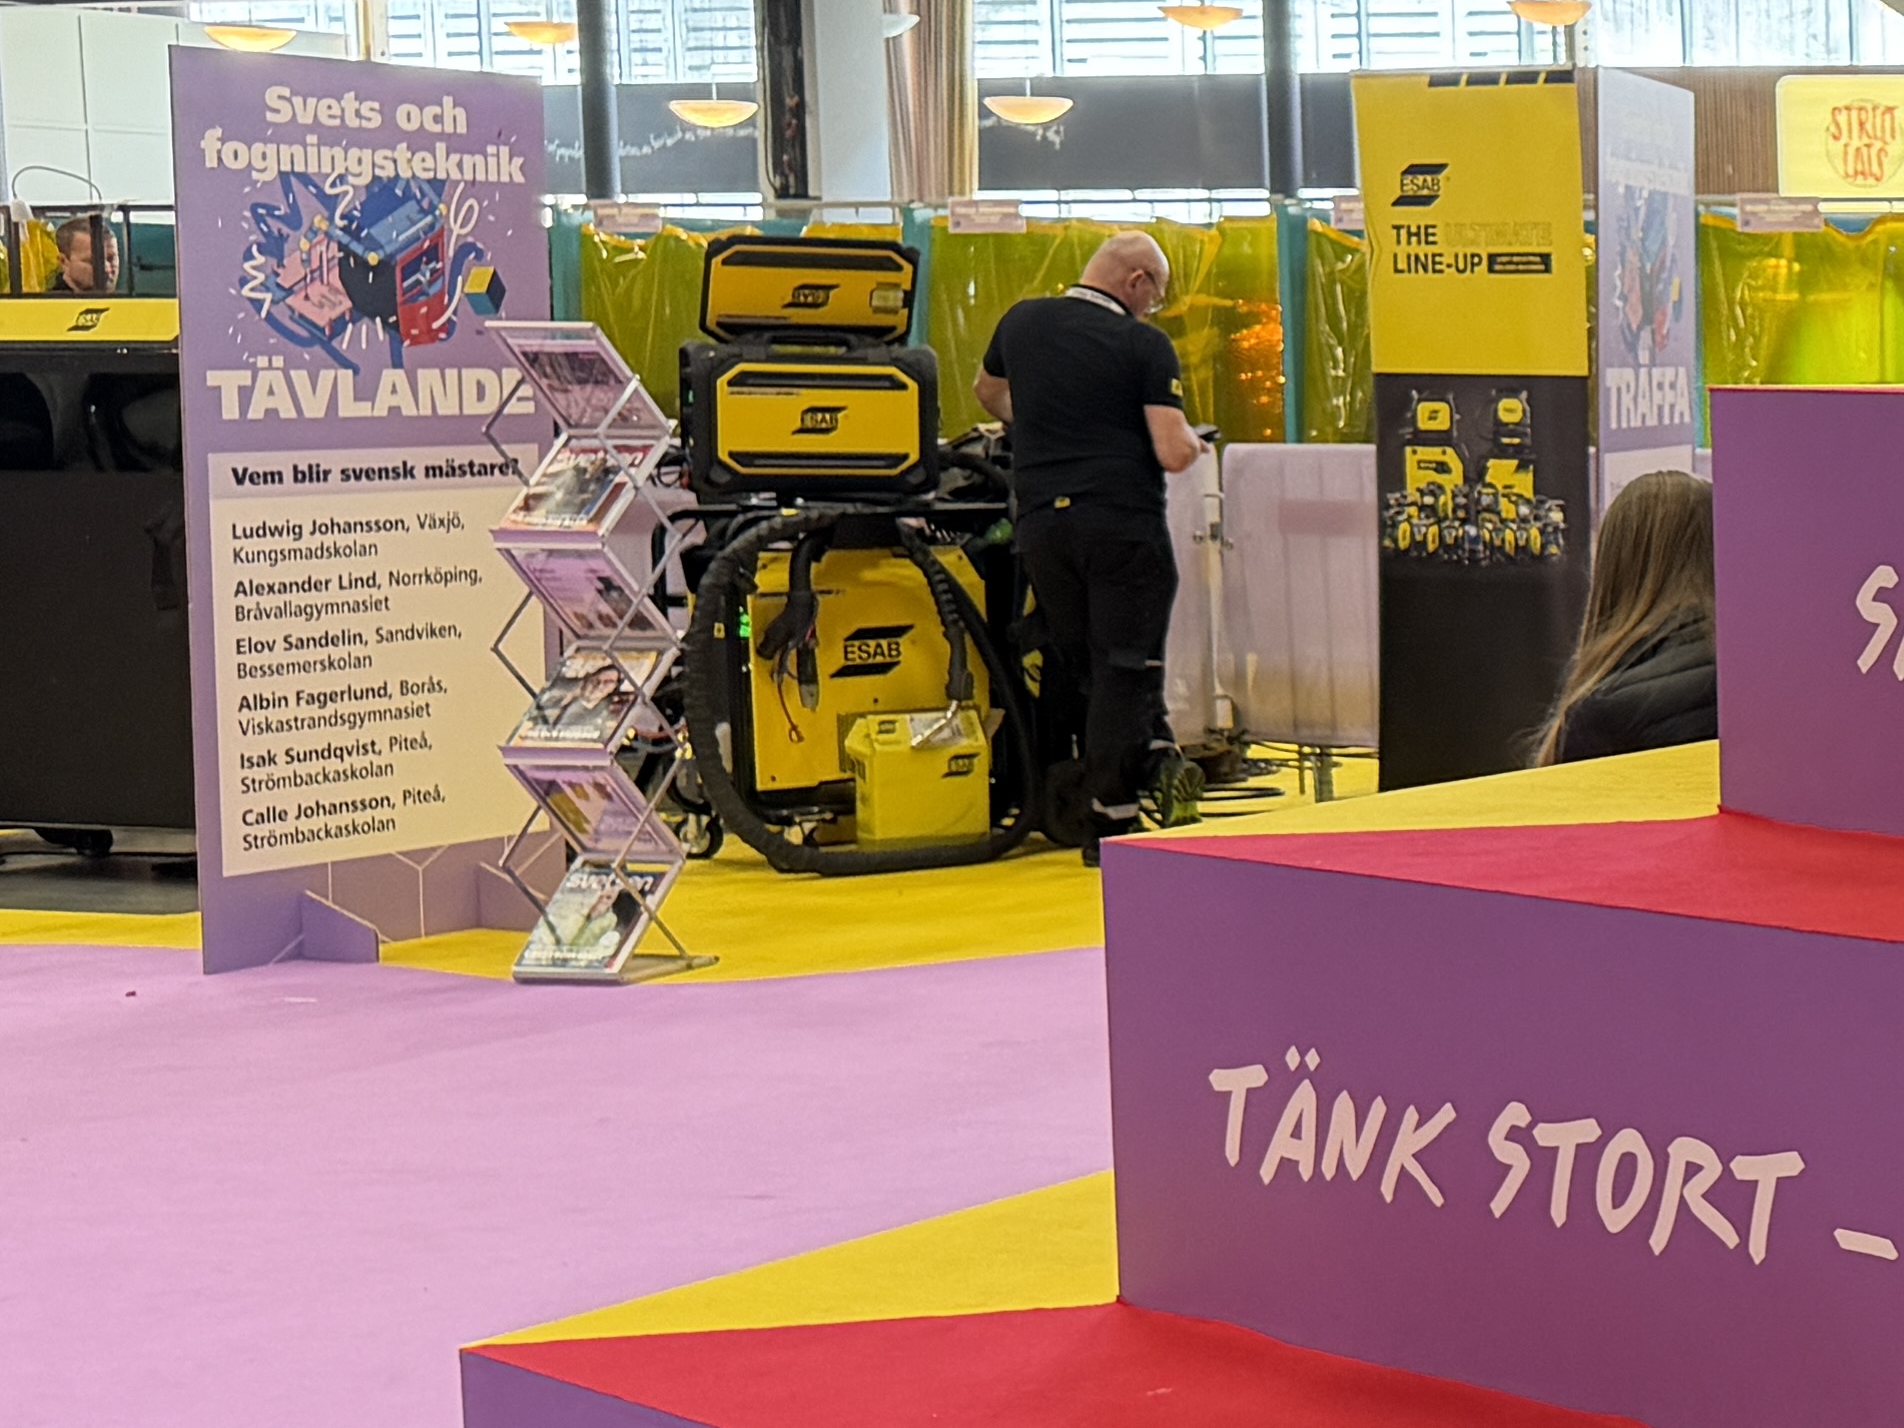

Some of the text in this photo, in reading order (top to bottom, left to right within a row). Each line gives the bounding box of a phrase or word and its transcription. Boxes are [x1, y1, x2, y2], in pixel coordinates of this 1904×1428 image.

[265, 86, 467, 134] Svets och
[201, 127, 525, 186] fogningsteknik
[1400, 176, 1441, 193] ESAB
[1391, 224, 1438, 246] THE
[1393, 253, 1483, 274] LINE-UP
[232, 458, 519, 487] Vem blir svensk mästare?
[232, 511, 466, 542] Ludwig Johansson, Växjö,
[232, 540, 379, 567] Kungsmadskolan
[234, 566, 483, 598] Alexander Lind, Norrköping,
[234, 595, 391, 623] Bråvallagymnasiet
[236, 622, 463, 656] Elov Sandelin, Sandviken,
[843, 641, 902, 662] ESAB
[237, 653, 374, 680] Bessemerskolan
[238, 675, 448, 713] Albin Fagerlund, Borås,
[238, 702, 432, 736] Viskastrandsgymnasiet
[240, 731, 433, 770] Isak Sundqvist, Piteå,
[240, 761, 395, 794] Strömbackaskolan
[242, 786, 446, 827] Calle Johansson, Piteå,
[242, 816, 397, 852] Strömbackaskolan
[1208, 1045, 1456, 1209] TÄNK
[1487, 1101, 1806, 1265] STORT
